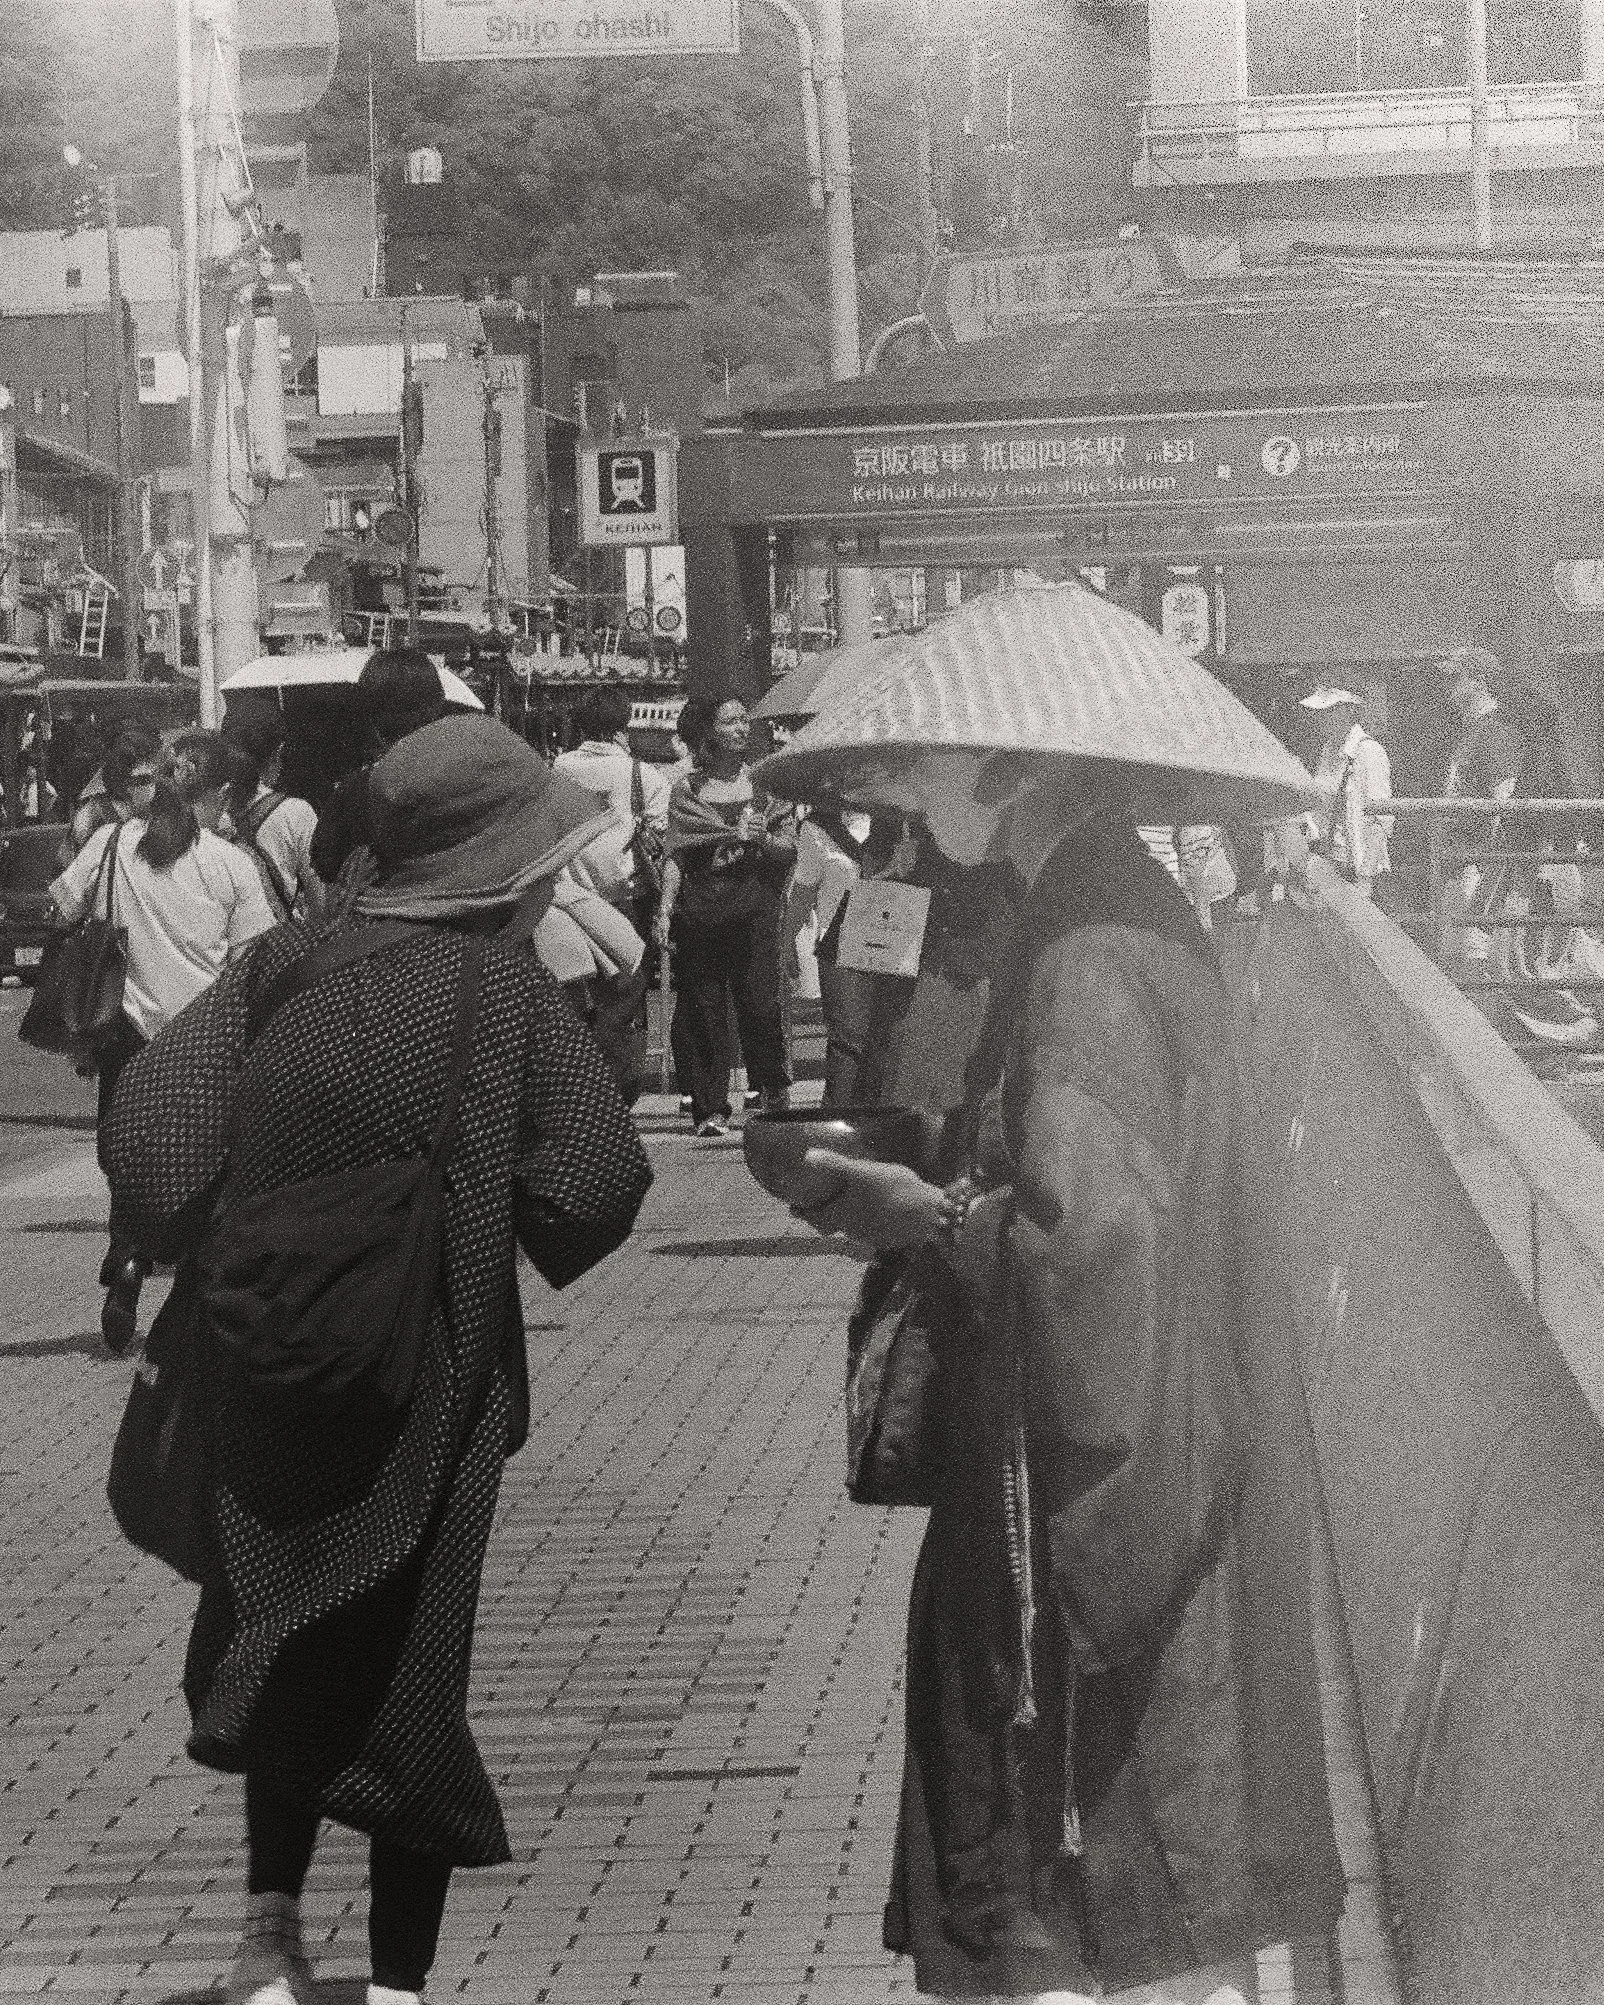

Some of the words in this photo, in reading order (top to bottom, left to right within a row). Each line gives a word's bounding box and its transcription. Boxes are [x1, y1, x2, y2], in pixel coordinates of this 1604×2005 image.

[485, 15, 558, 45] Shijo
[575, 11, 671, 40] ohashi
[852, 444, 968, 477] 京阪電車
[980, 436, 1127, 472] 祇園四条駅
[852, 483, 917, 502] Keihan
[1106, 474, 1177, 492] Station
